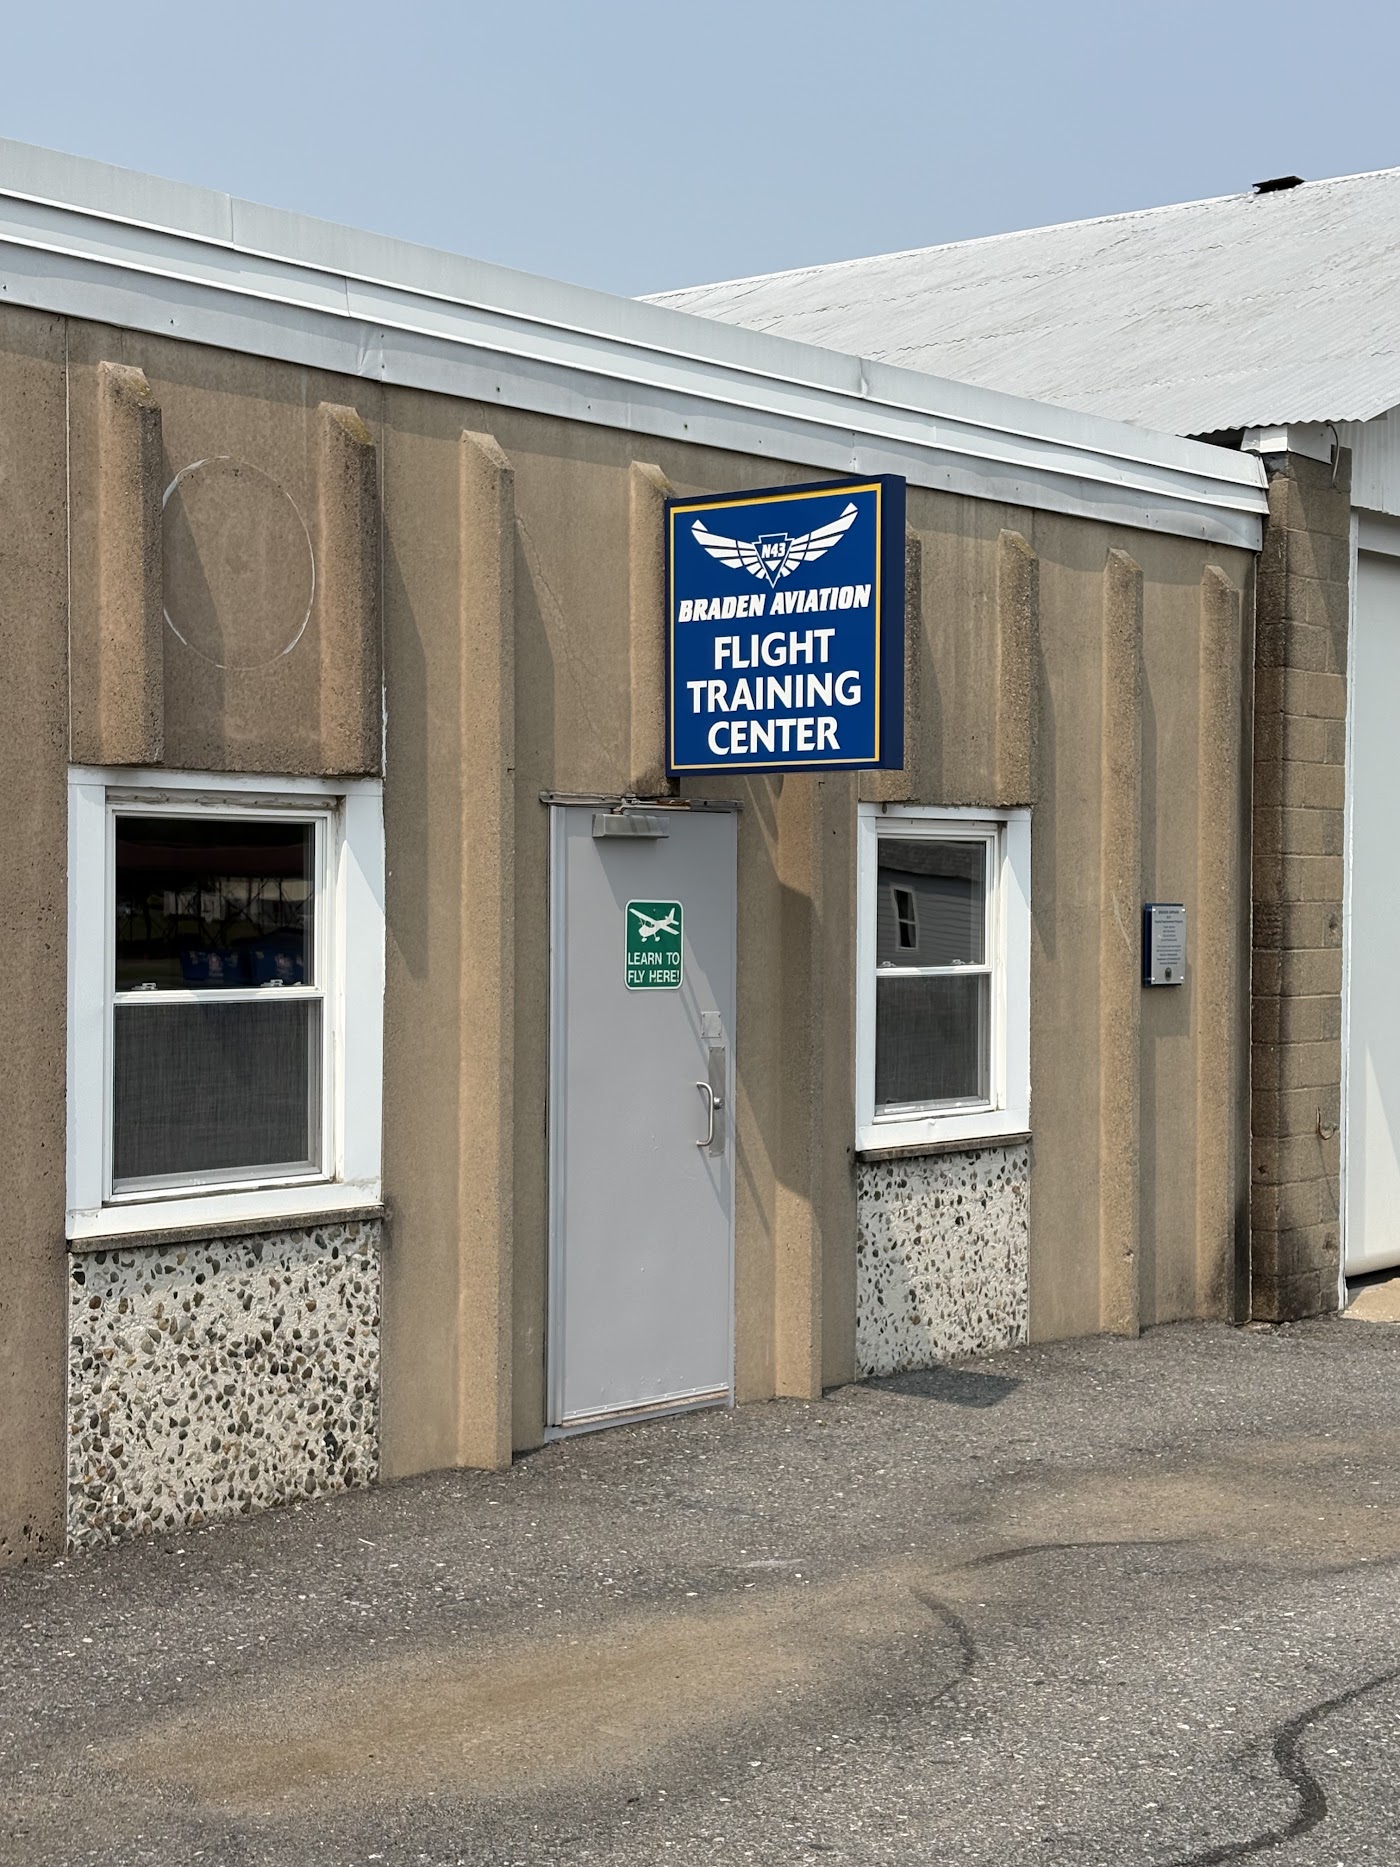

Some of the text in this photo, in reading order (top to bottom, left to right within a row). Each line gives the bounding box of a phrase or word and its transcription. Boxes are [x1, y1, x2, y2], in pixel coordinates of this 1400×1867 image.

[761, 543, 786, 558] N43
[678, 584, 872, 623] BRADEN AVIATION
[714, 629, 835, 670] FLIGHT
[687, 670, 861, 713] TRAINING
[708, 717, 840, 755] CENTER
[628, 952, 680, 965] LEARN TO
[628, 970, 680, 983] FLY HERE!
